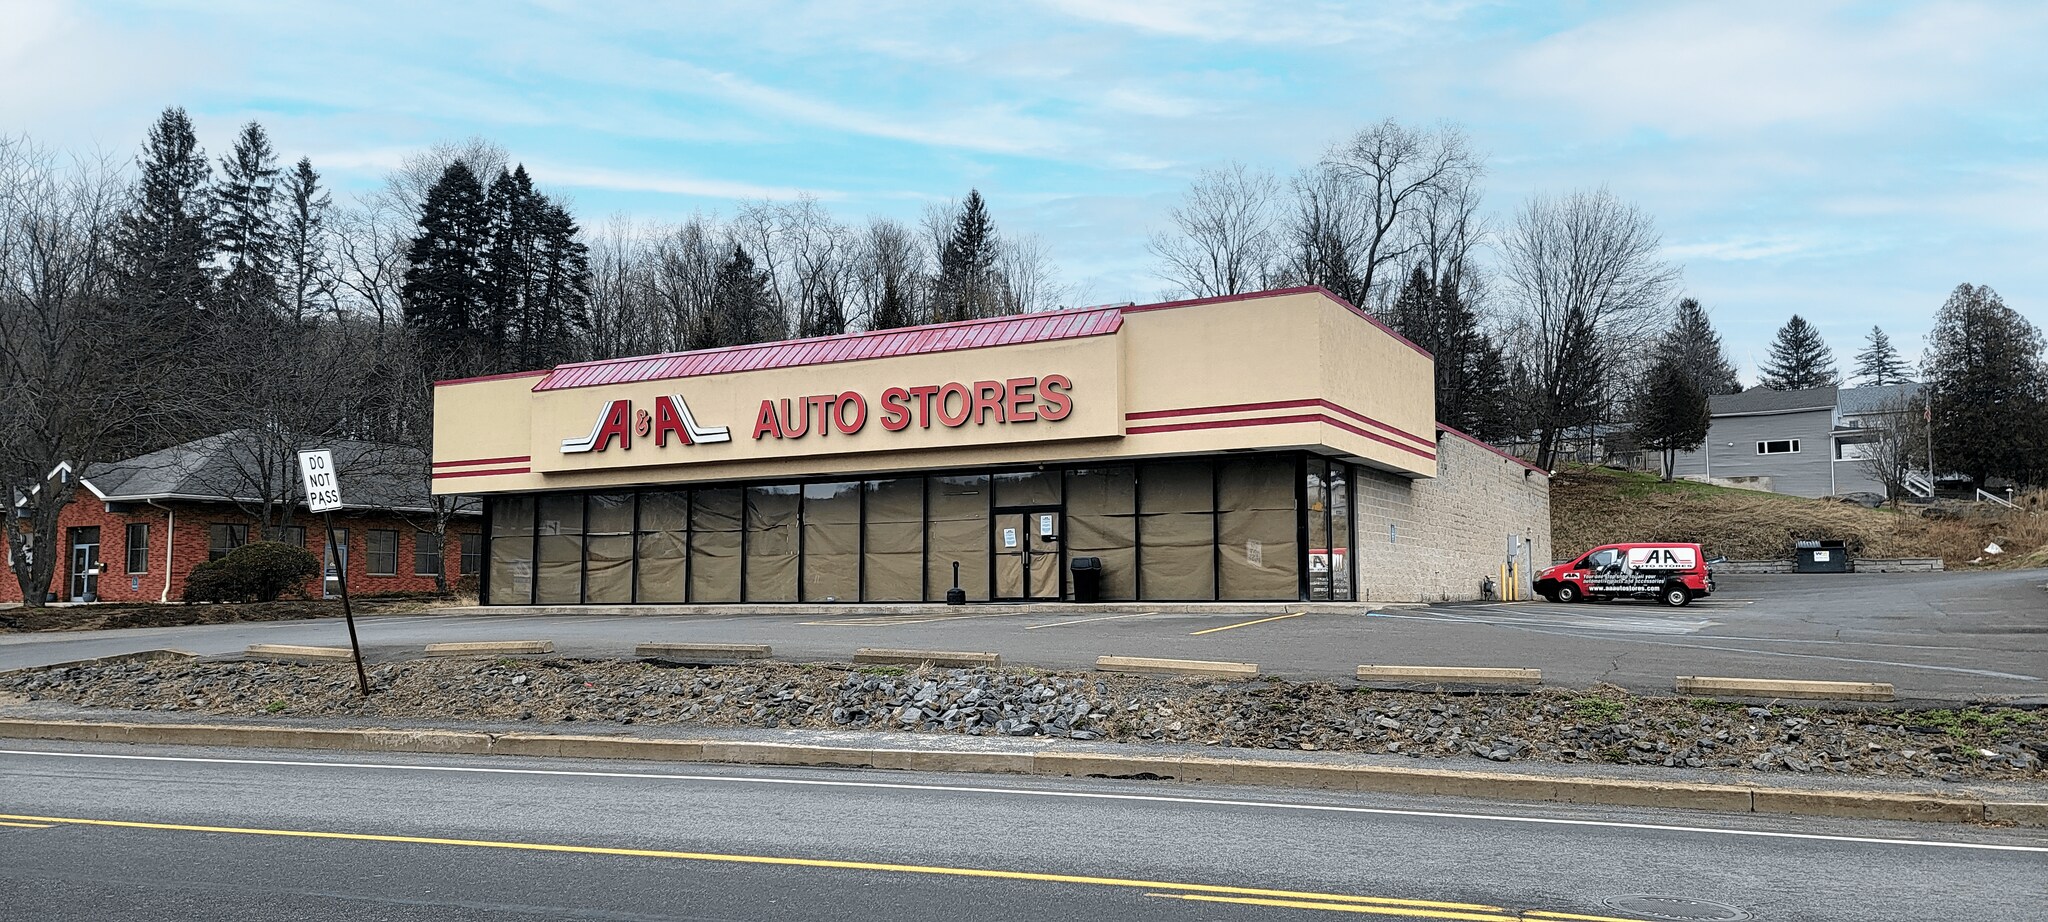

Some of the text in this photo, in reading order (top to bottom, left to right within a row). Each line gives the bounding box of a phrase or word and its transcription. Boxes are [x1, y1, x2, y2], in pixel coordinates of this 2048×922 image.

[752, 391, 867, 439] AUTO
[880, 374, 1072, 431] STORES
[309, 456, 324, 470] DO
[309, 473, 330, 487] NOT
[310, 489, 338, 505] PASS
